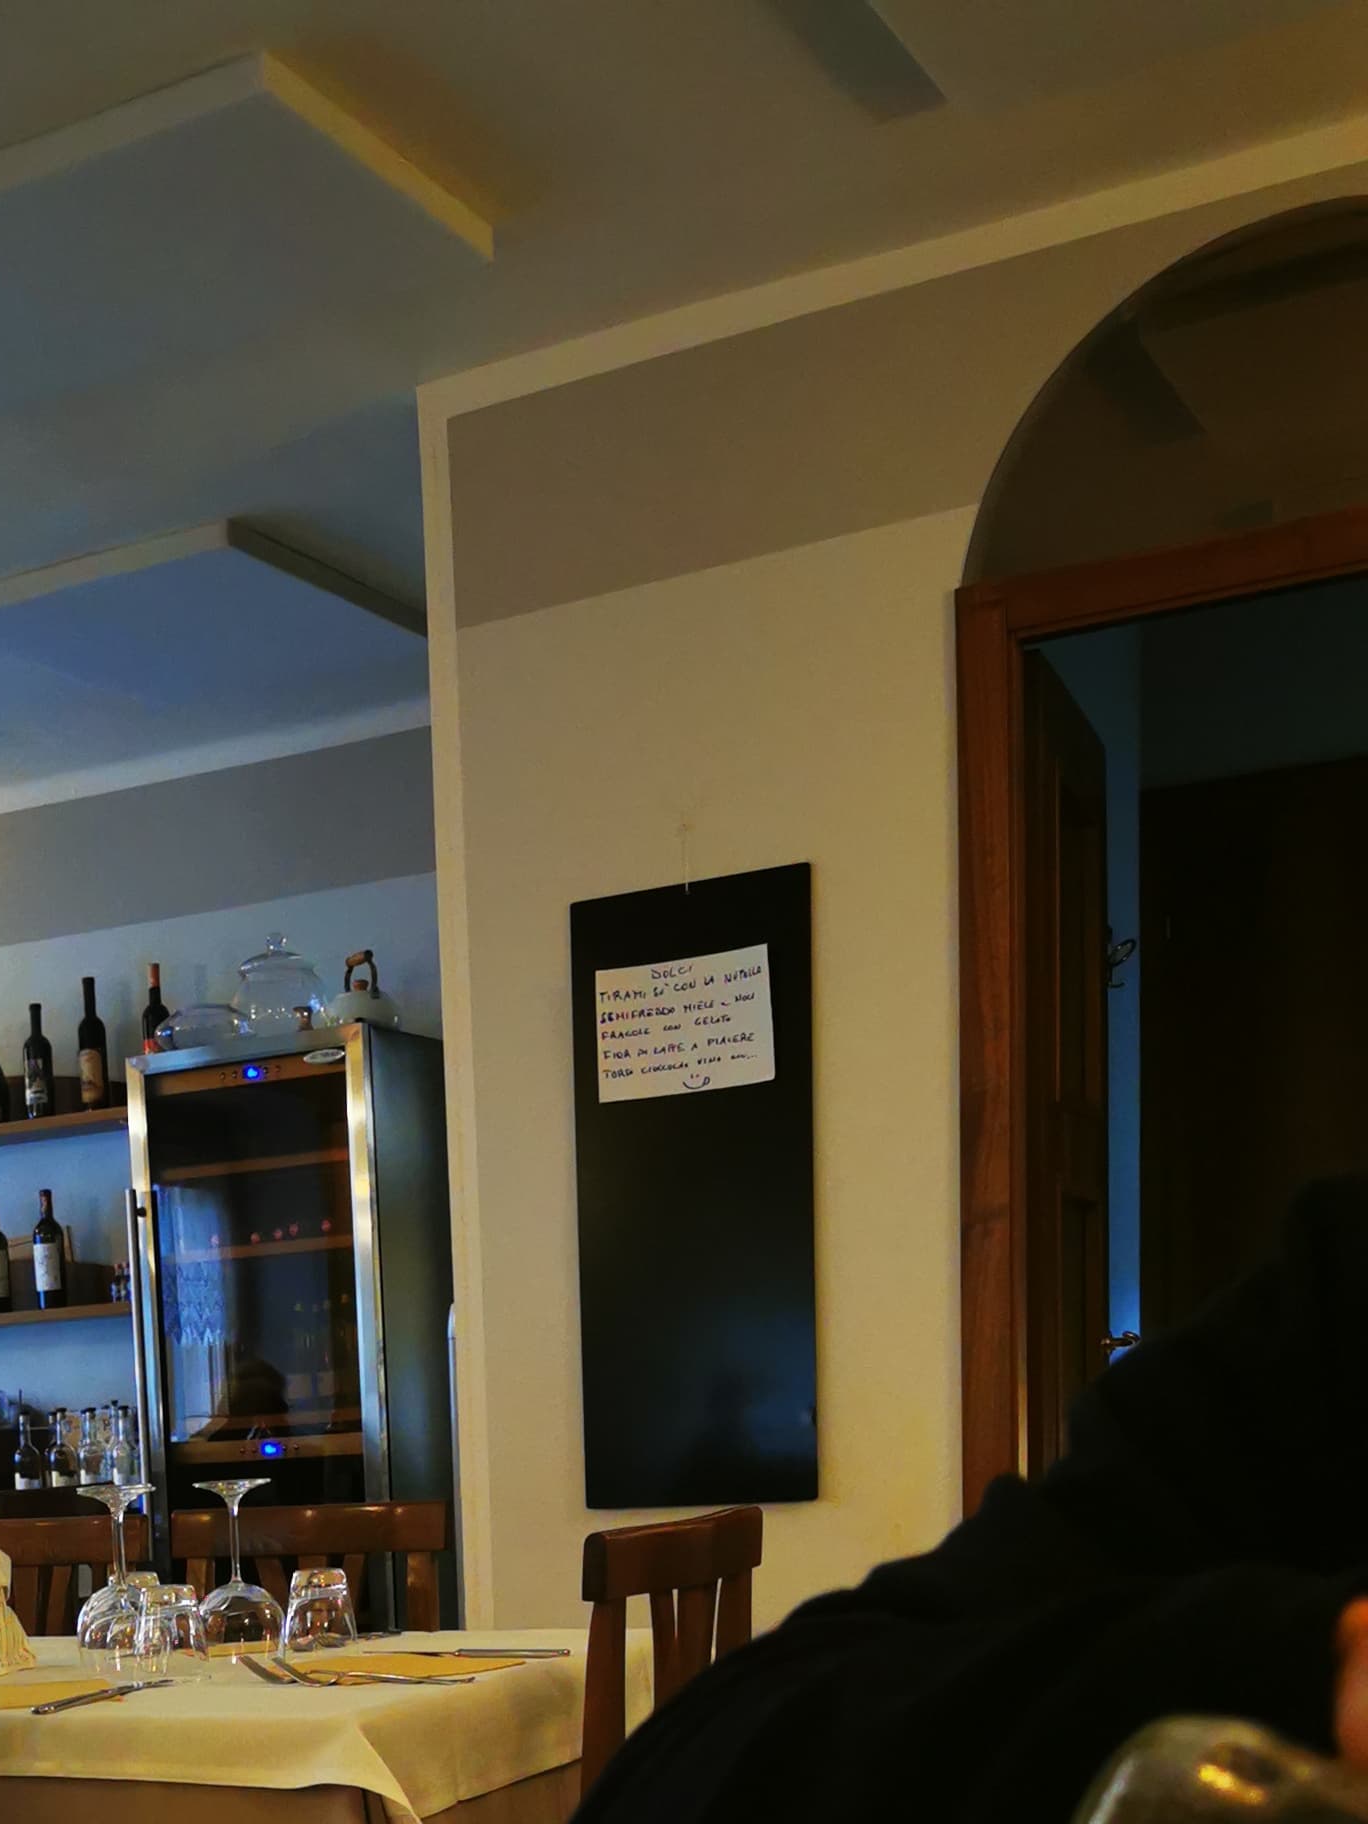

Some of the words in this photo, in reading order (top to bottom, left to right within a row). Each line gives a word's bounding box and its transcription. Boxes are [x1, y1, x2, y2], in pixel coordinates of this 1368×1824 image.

[651, 966, 692, 980] DOLCI
[673, 979, 696, 992] CON
[704, 975, 715, 986] LA
